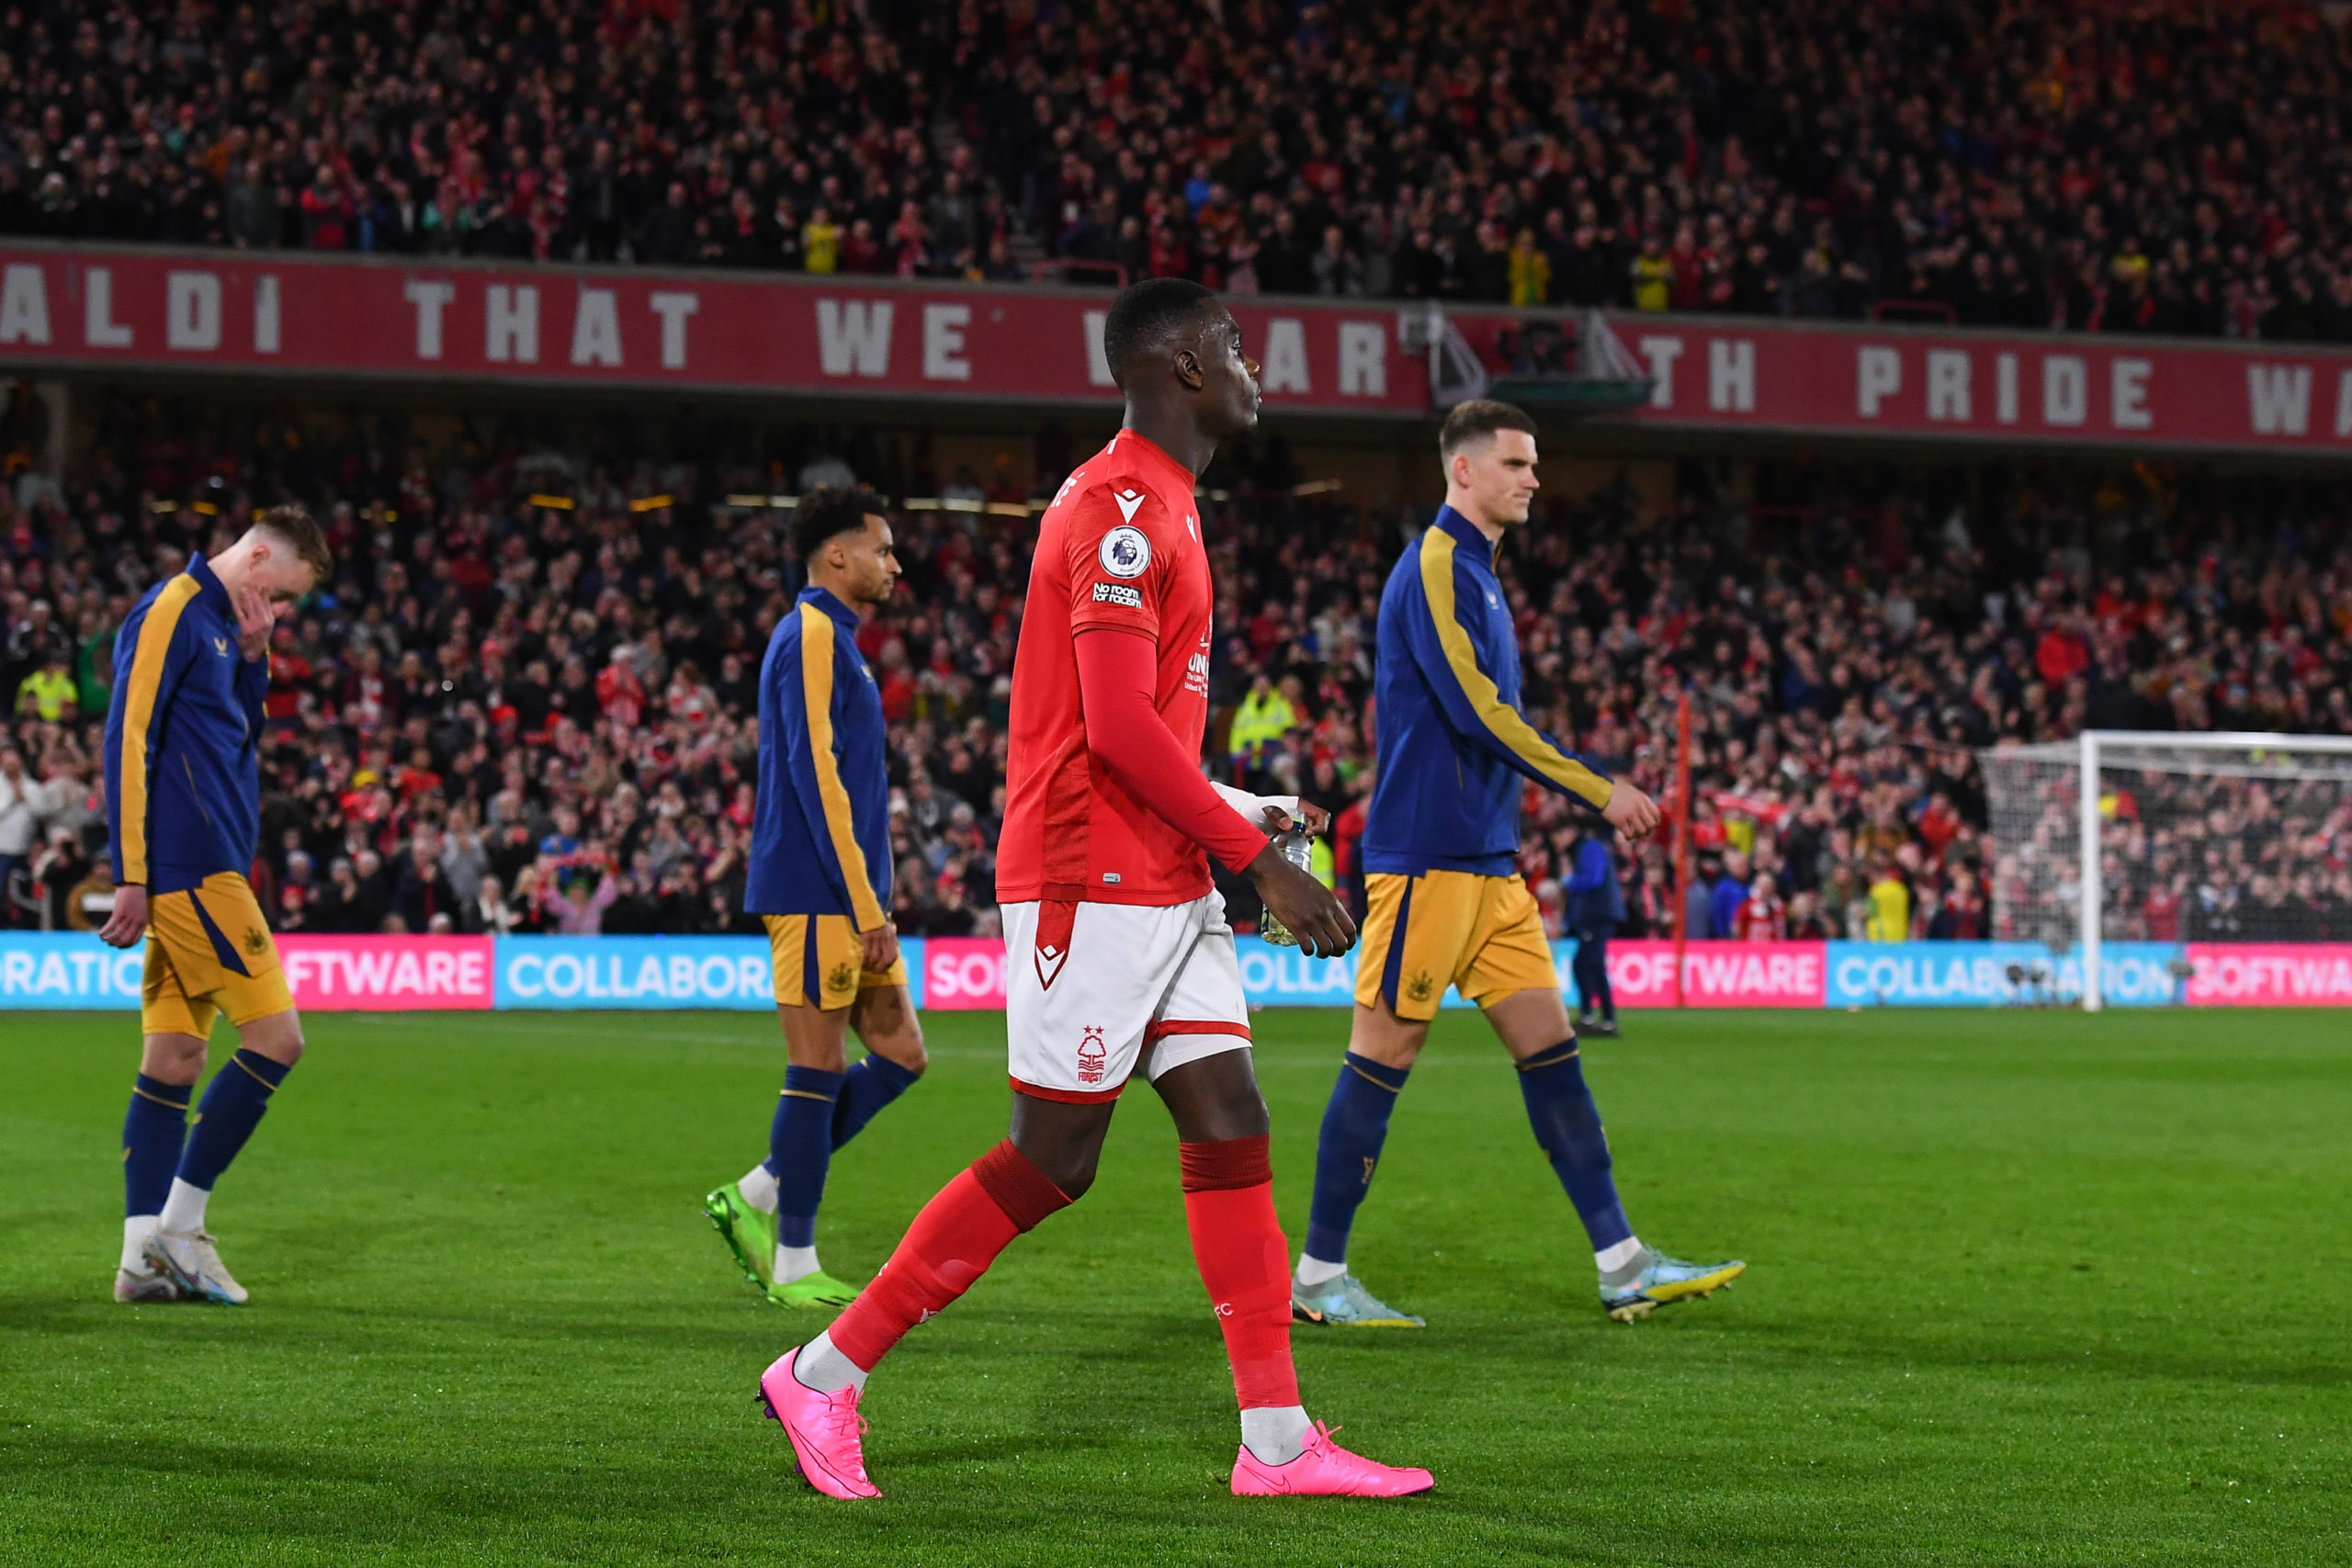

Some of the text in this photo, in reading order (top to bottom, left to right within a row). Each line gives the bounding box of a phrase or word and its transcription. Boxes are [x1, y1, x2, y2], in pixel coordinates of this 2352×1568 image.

[404, 278, 699, 369] THAT
[816, 298, 970, 381] WE
[1857, 344, 2154, 430] PRIDE
[1093, 582, 1139, 600] No room
[1108, 593, 1142, 610] racism
